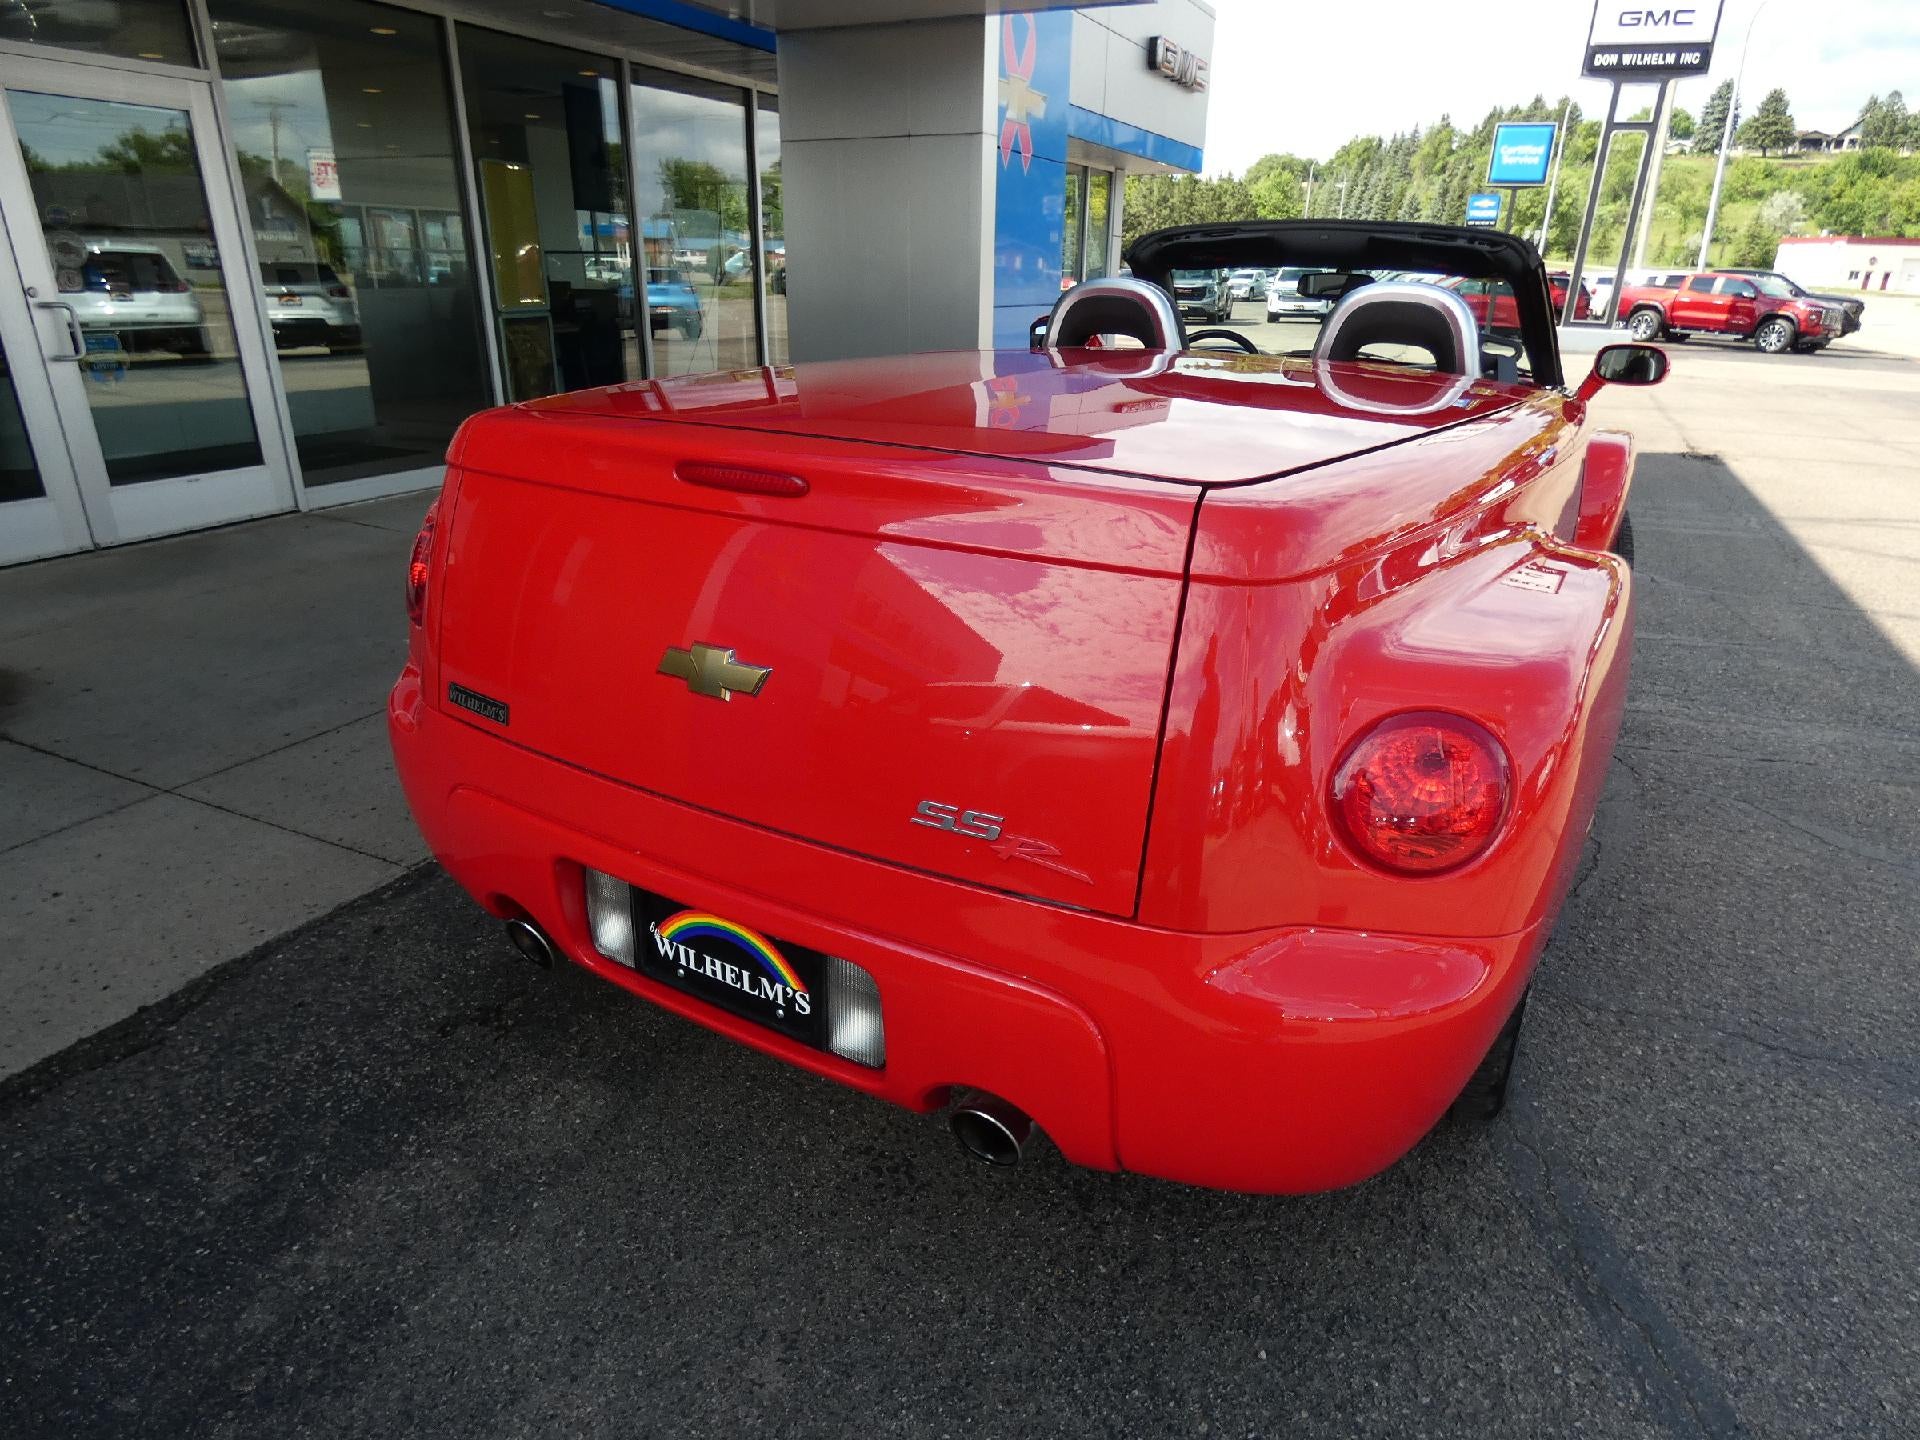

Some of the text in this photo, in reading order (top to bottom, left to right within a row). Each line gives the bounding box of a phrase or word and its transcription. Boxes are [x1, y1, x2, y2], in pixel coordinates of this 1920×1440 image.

[1617, 9, 1697, 27] GMC
[1148, 35, 1208, 93] GMC
[1593, 53, 1619, 67] DON
[1621, 52, 1677, 66] WILHELM
[449, 687, 505, 721] WILHELM'S
[653, 935, 811, 1015] WILHELM'S
